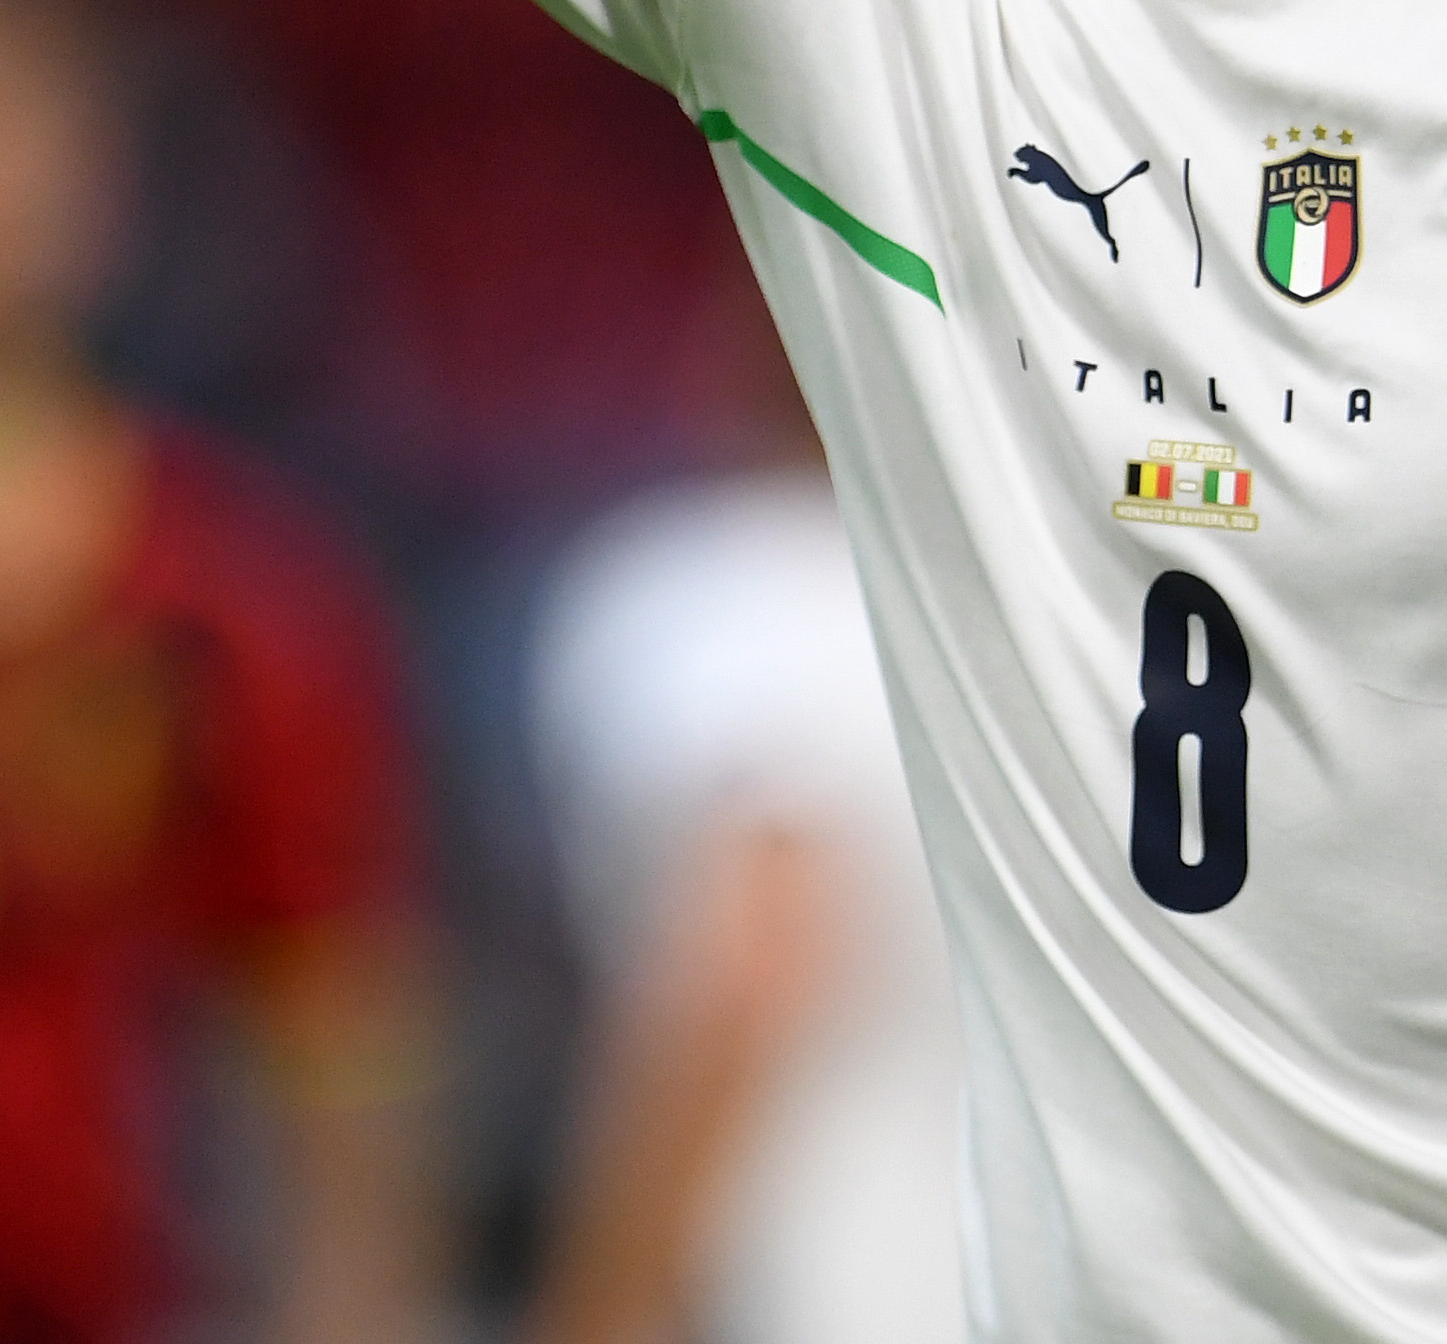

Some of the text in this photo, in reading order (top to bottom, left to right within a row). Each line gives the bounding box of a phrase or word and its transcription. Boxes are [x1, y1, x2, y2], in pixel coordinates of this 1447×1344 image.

[1268, 163, 1353, 193] ITALIA
[1016, 337, 1372, 424] ITALIA
[1128, 569, 1251, 914] 8
